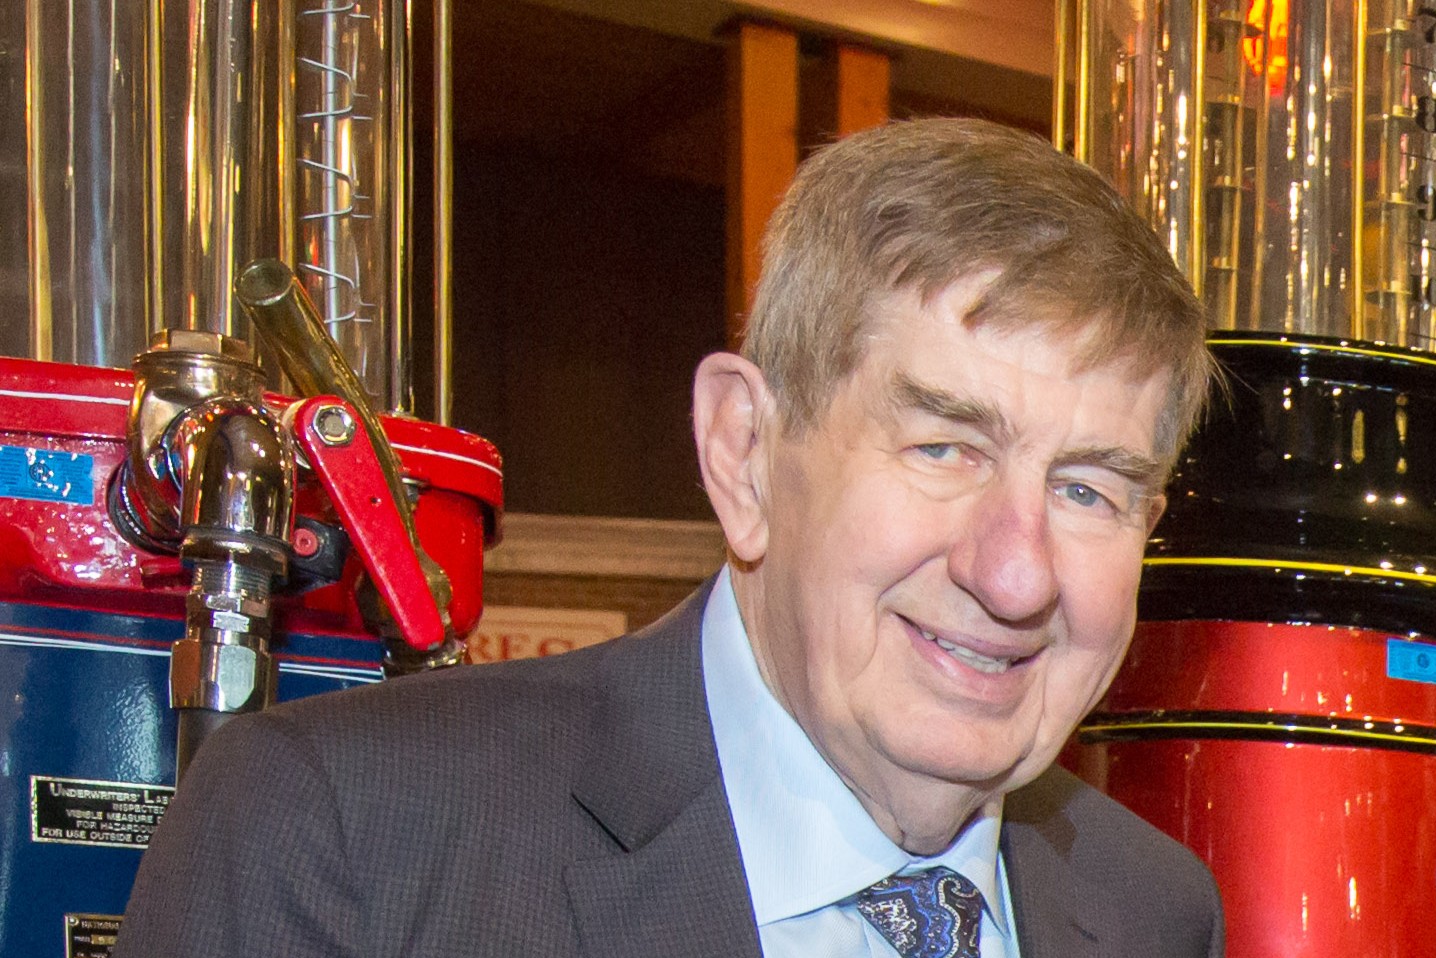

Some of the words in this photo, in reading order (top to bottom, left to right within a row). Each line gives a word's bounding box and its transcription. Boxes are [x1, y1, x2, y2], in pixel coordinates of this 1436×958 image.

[143, 789, 169, 805] LAB
[106, 811, 153, 824] MEASURE
[76, 820, 97, 830] FOR
[41, 827, 63, 838] FOR
[66, 829, 87, 840] USE
[89, 831, 133, 843] OUTSIDE
